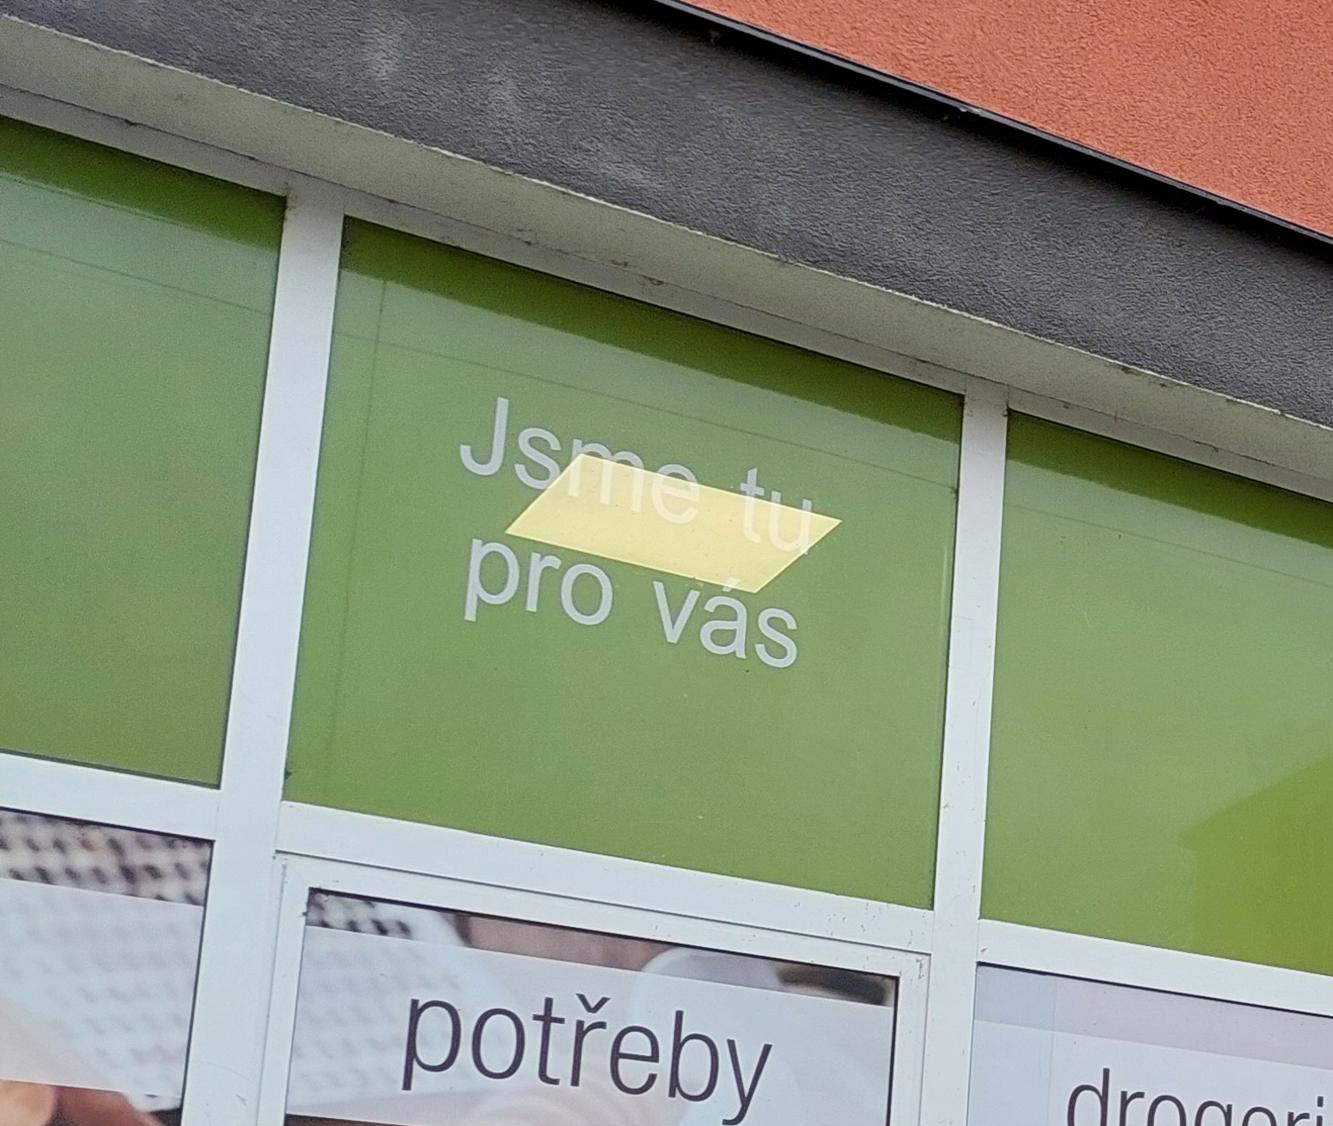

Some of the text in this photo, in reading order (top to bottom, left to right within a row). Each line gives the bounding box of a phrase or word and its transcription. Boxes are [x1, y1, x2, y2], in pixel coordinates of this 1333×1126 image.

[459, 396, 814, 556] Jsme tu
[463, 537, 799, 669] pro vás
[401, 993, 773, 1126] potřeby
